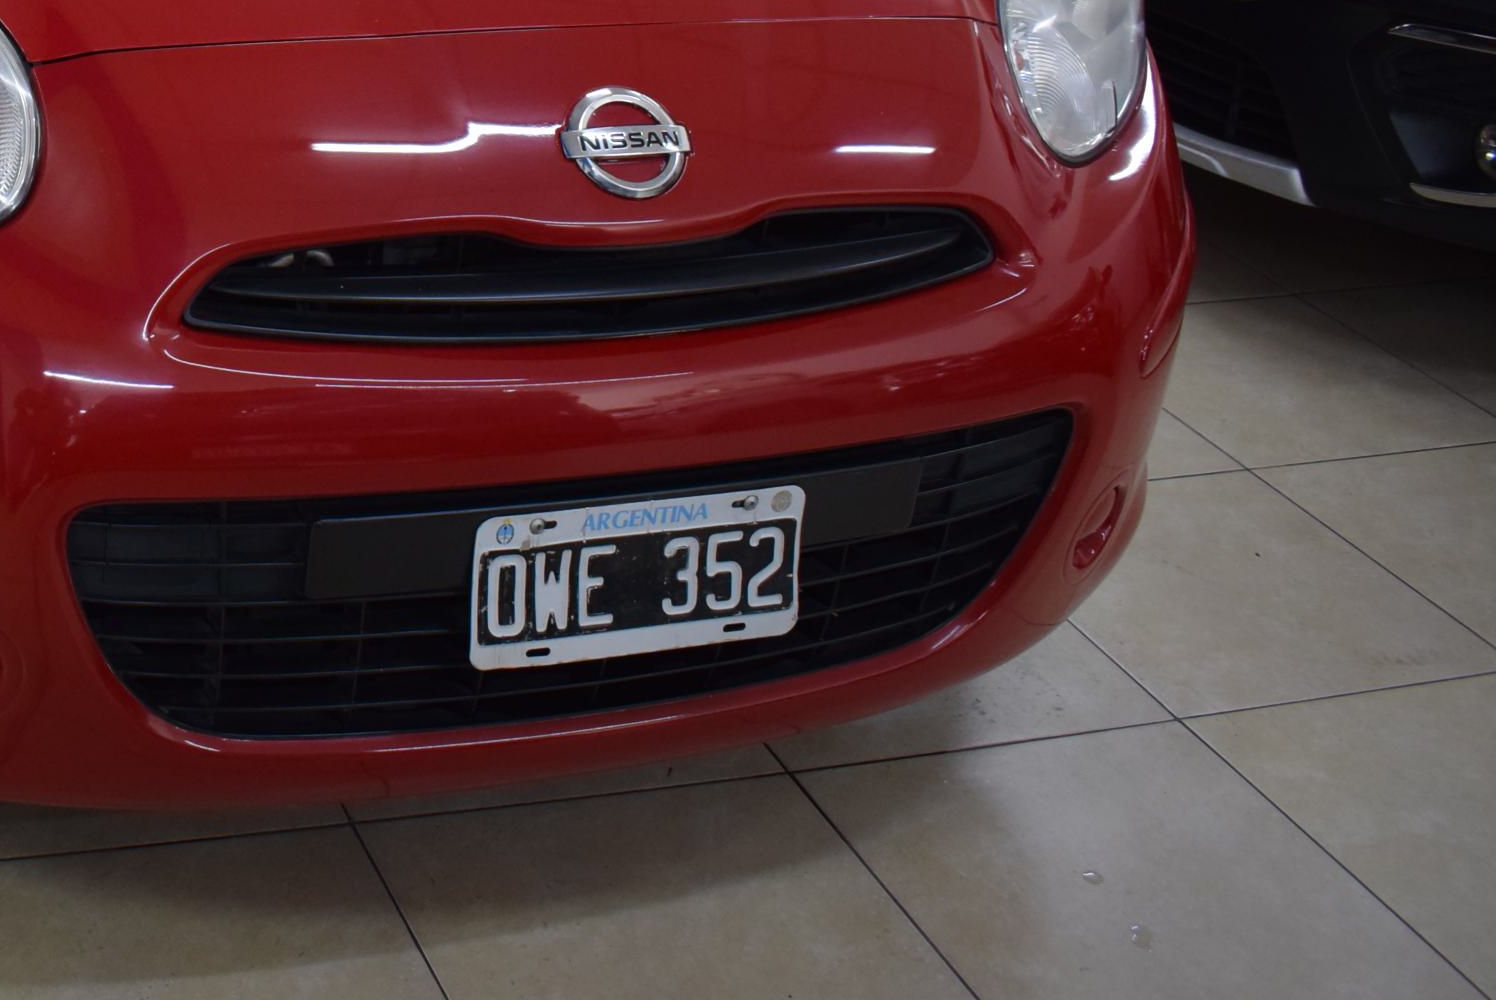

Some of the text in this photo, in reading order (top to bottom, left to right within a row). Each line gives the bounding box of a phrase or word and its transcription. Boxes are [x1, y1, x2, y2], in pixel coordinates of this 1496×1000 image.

[579, 131, 680, 151] NISSAN
[581, 502, 709, 532] ARGENTINA
[486, 525, 786, 639] OWE 352
